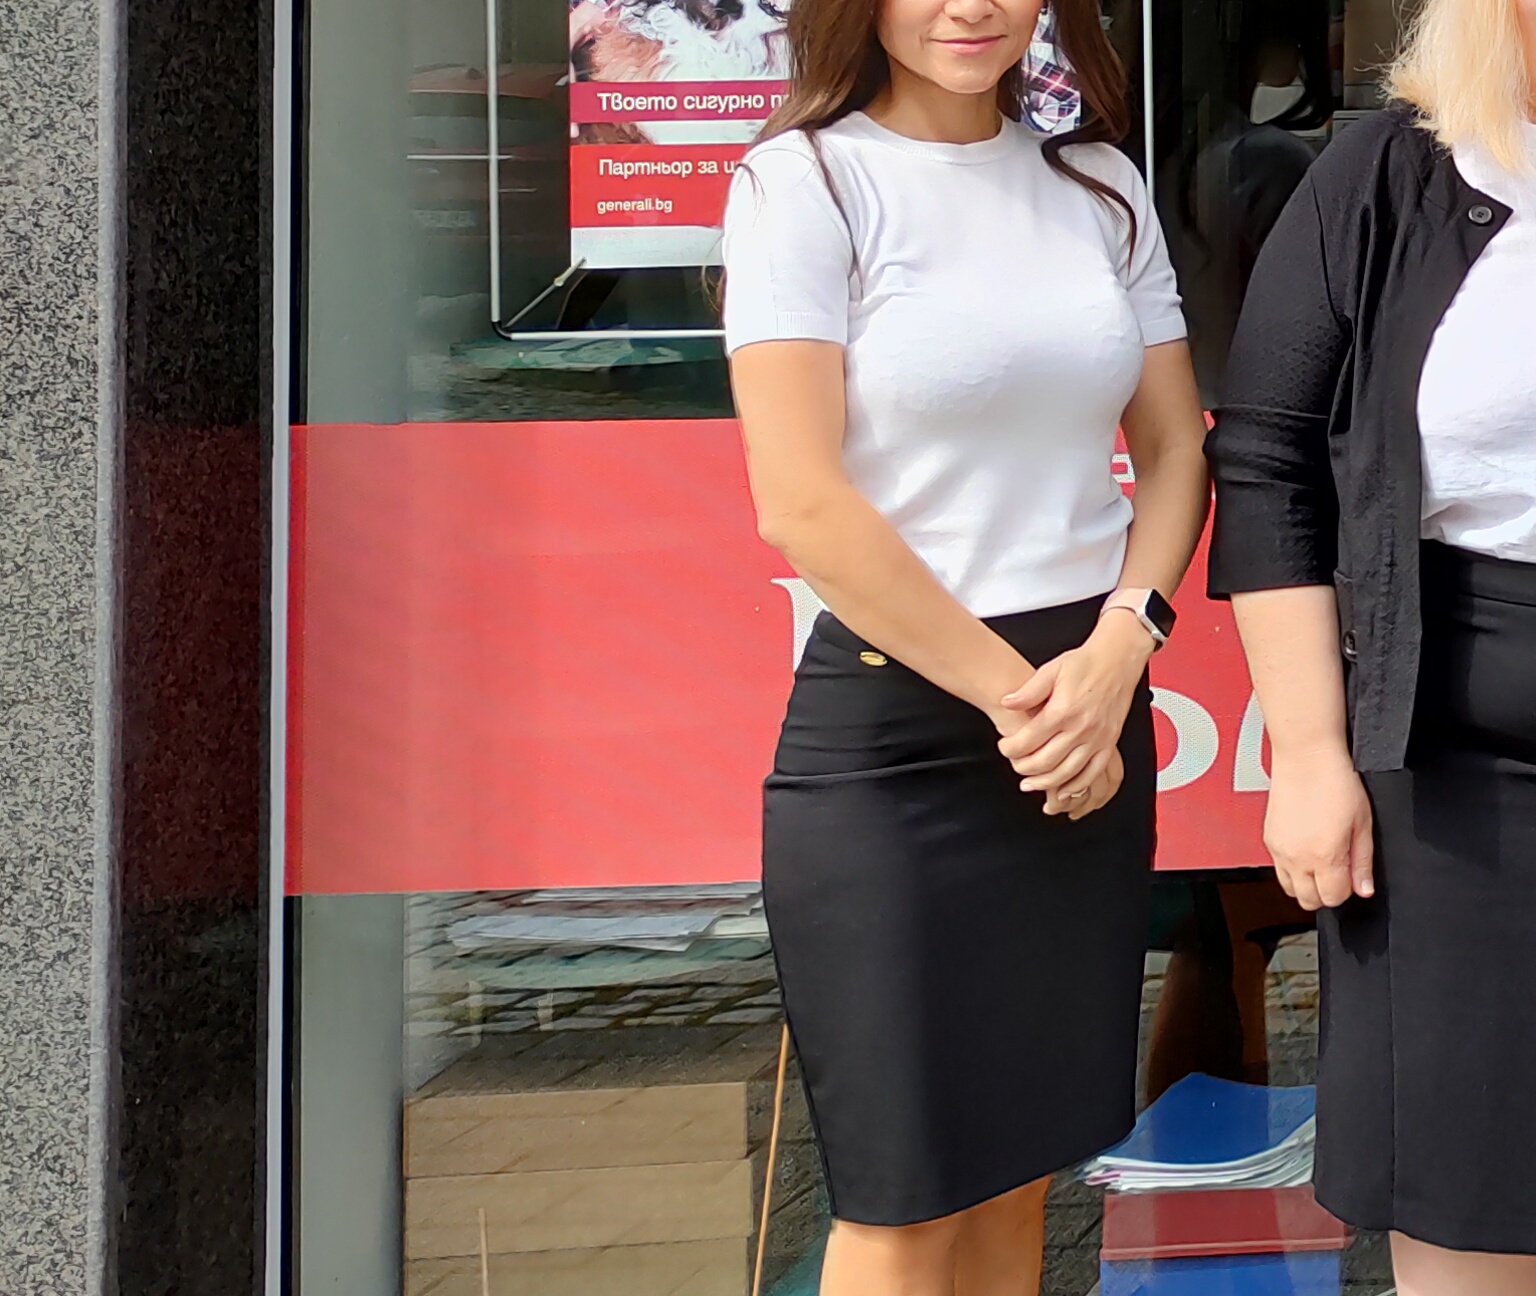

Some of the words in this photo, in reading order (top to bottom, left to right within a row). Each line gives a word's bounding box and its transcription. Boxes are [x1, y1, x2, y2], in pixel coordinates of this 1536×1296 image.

[597, 92, 677, 111] Твоето
[683, 93, 765, 115] сигурно
[599, 158, 693, 180] Партньор
[697, 161, 719, 175] за
[597, 198, 673, 213] generali.bg
